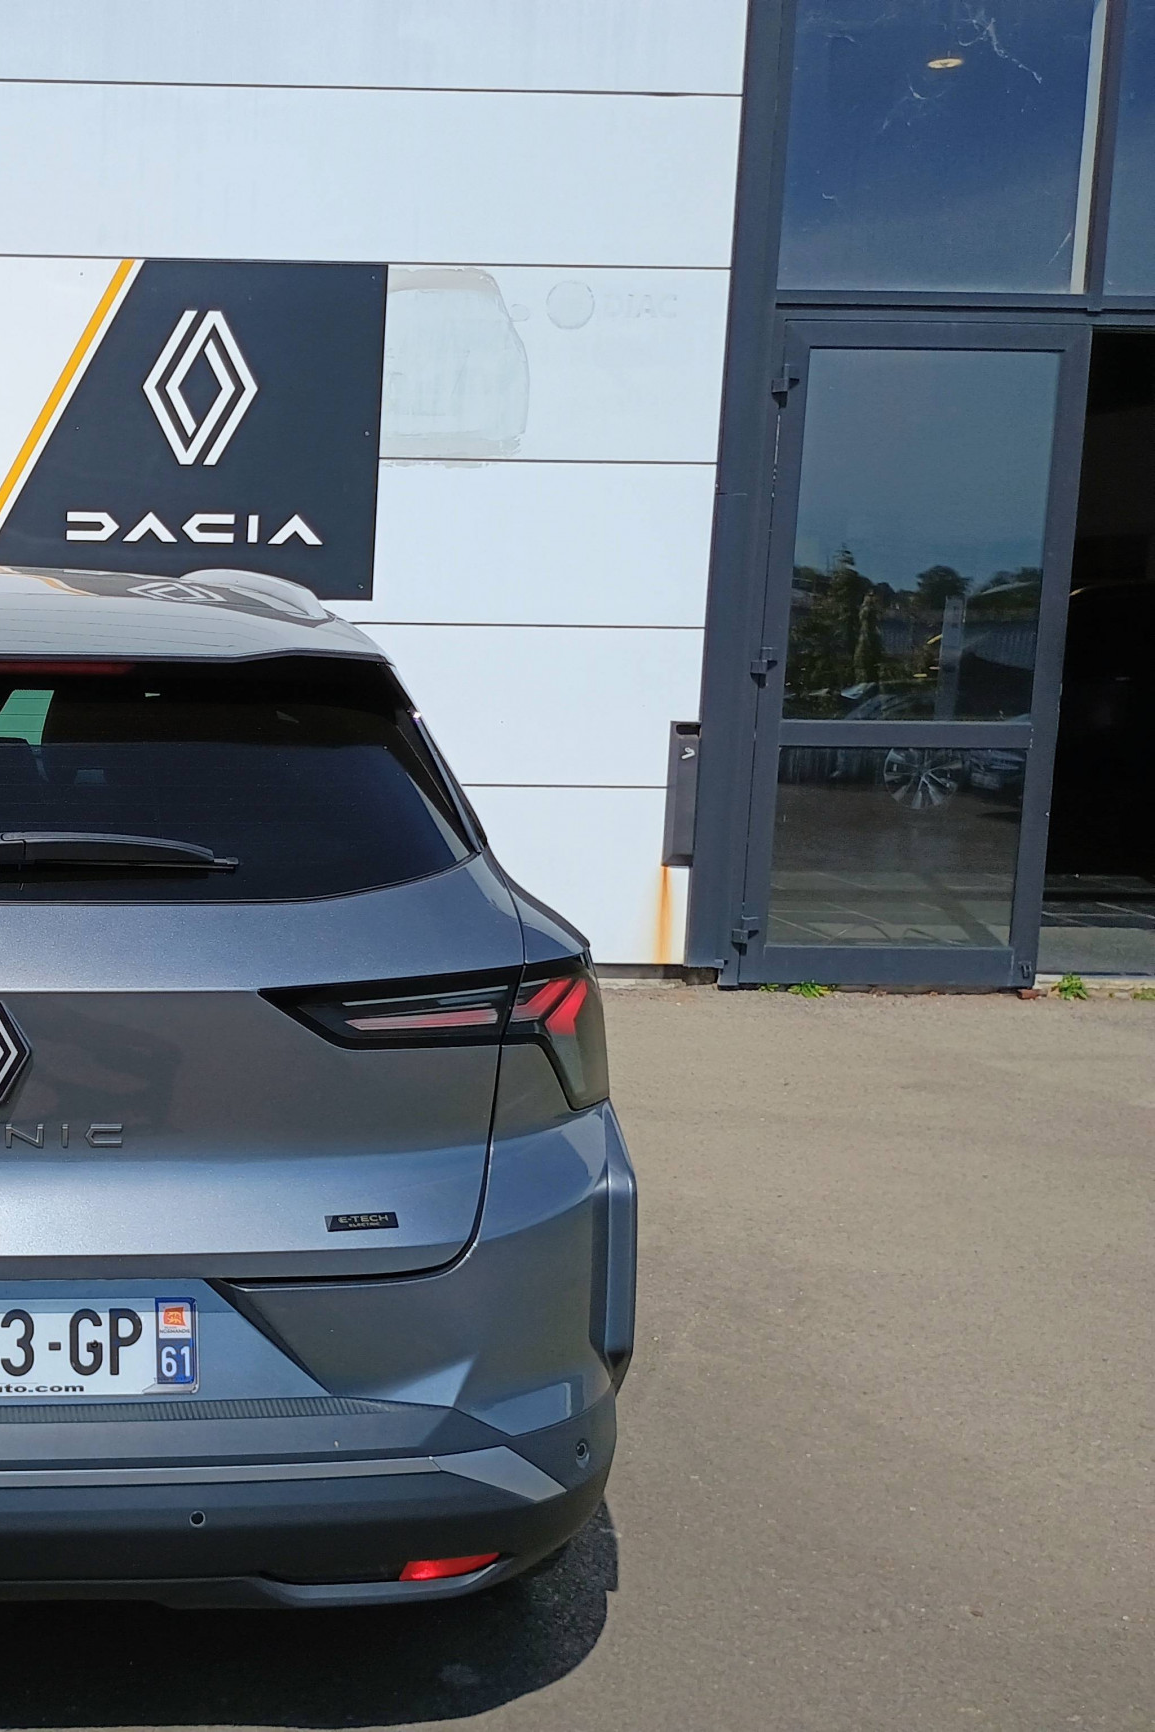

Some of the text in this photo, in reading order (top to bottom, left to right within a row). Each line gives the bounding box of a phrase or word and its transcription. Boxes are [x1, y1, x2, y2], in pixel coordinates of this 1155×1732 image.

[65, 511, 323, 546] DACIA
[337, 1214, 389, 1224] E-TECH
[161, 1346, 191, 1377] 61
